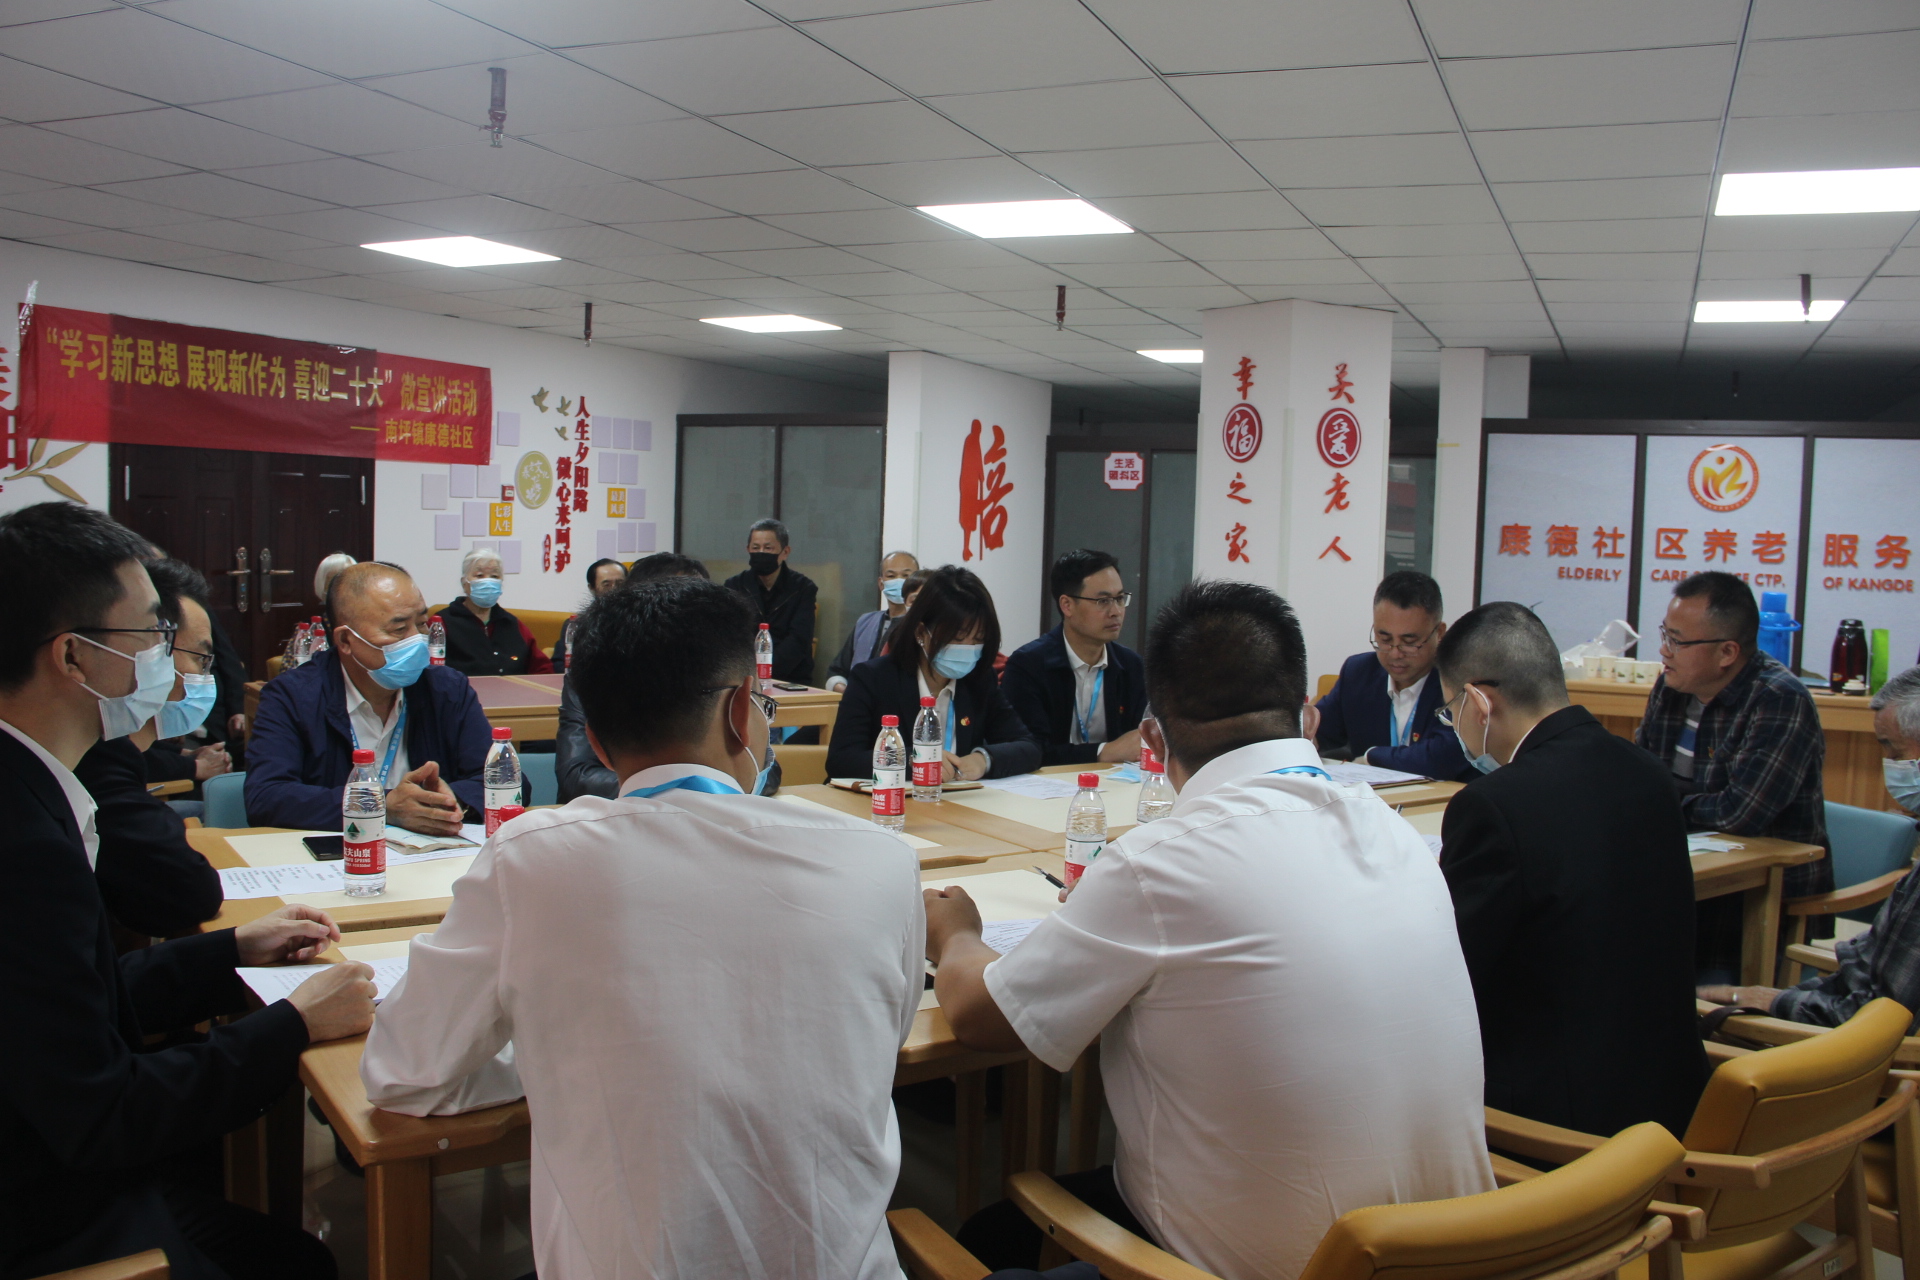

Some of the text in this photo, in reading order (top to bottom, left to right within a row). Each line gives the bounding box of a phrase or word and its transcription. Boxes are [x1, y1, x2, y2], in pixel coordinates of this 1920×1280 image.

[186, 345, 287, 398] 展现新作为
[400, 371, 478, 417] 微宣讲活动
[574, 395, 591, 512] 人生夕阳路
[1113, 458, 1135, 469] 生活
[494, 505, 511, 517] 七彩
[494, 519, 511, 532] 人生
[1557, 566, 1622, 581] ELDERLY
[1651, 569, 1689, 582] CARE
[1823, 576, 1844, 590] OF
[1847, 577, 1914, 593] KANGDE
